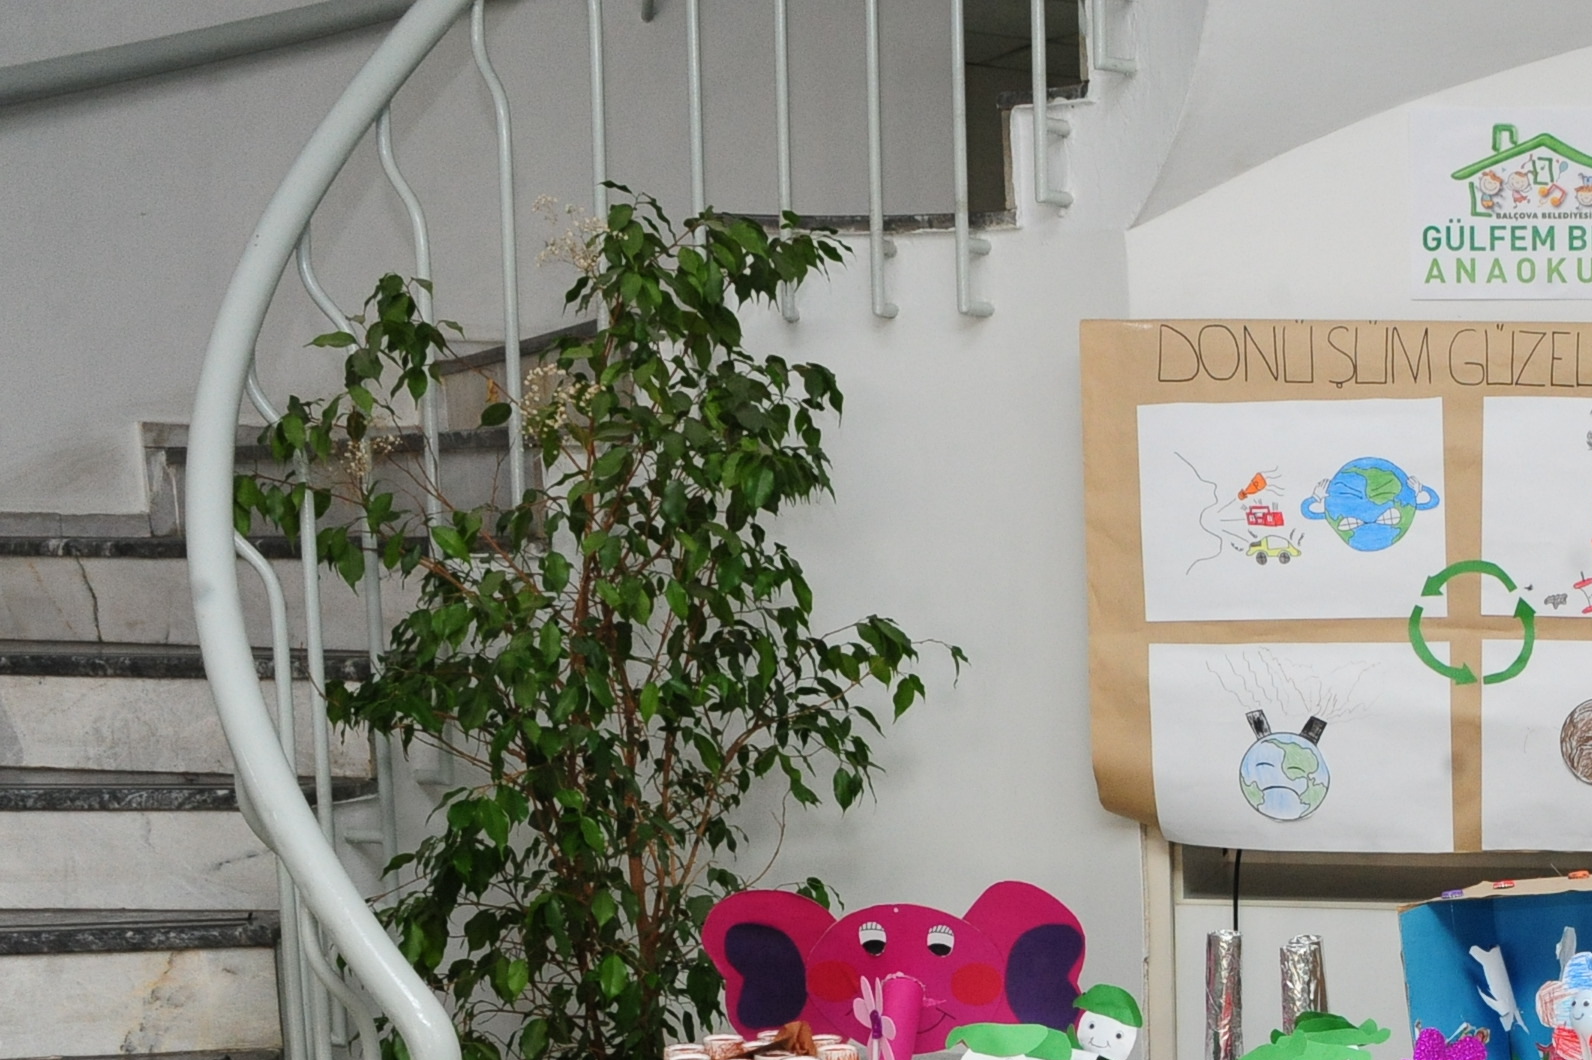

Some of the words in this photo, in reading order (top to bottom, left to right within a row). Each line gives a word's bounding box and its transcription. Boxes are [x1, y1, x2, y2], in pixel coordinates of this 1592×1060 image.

[1496, 212, 1539, 222] BALÇOVA
[1541, 210, 1592, 220] BELEDİYESİ
[1422, 218, 1555, 251] GÜLFEM
